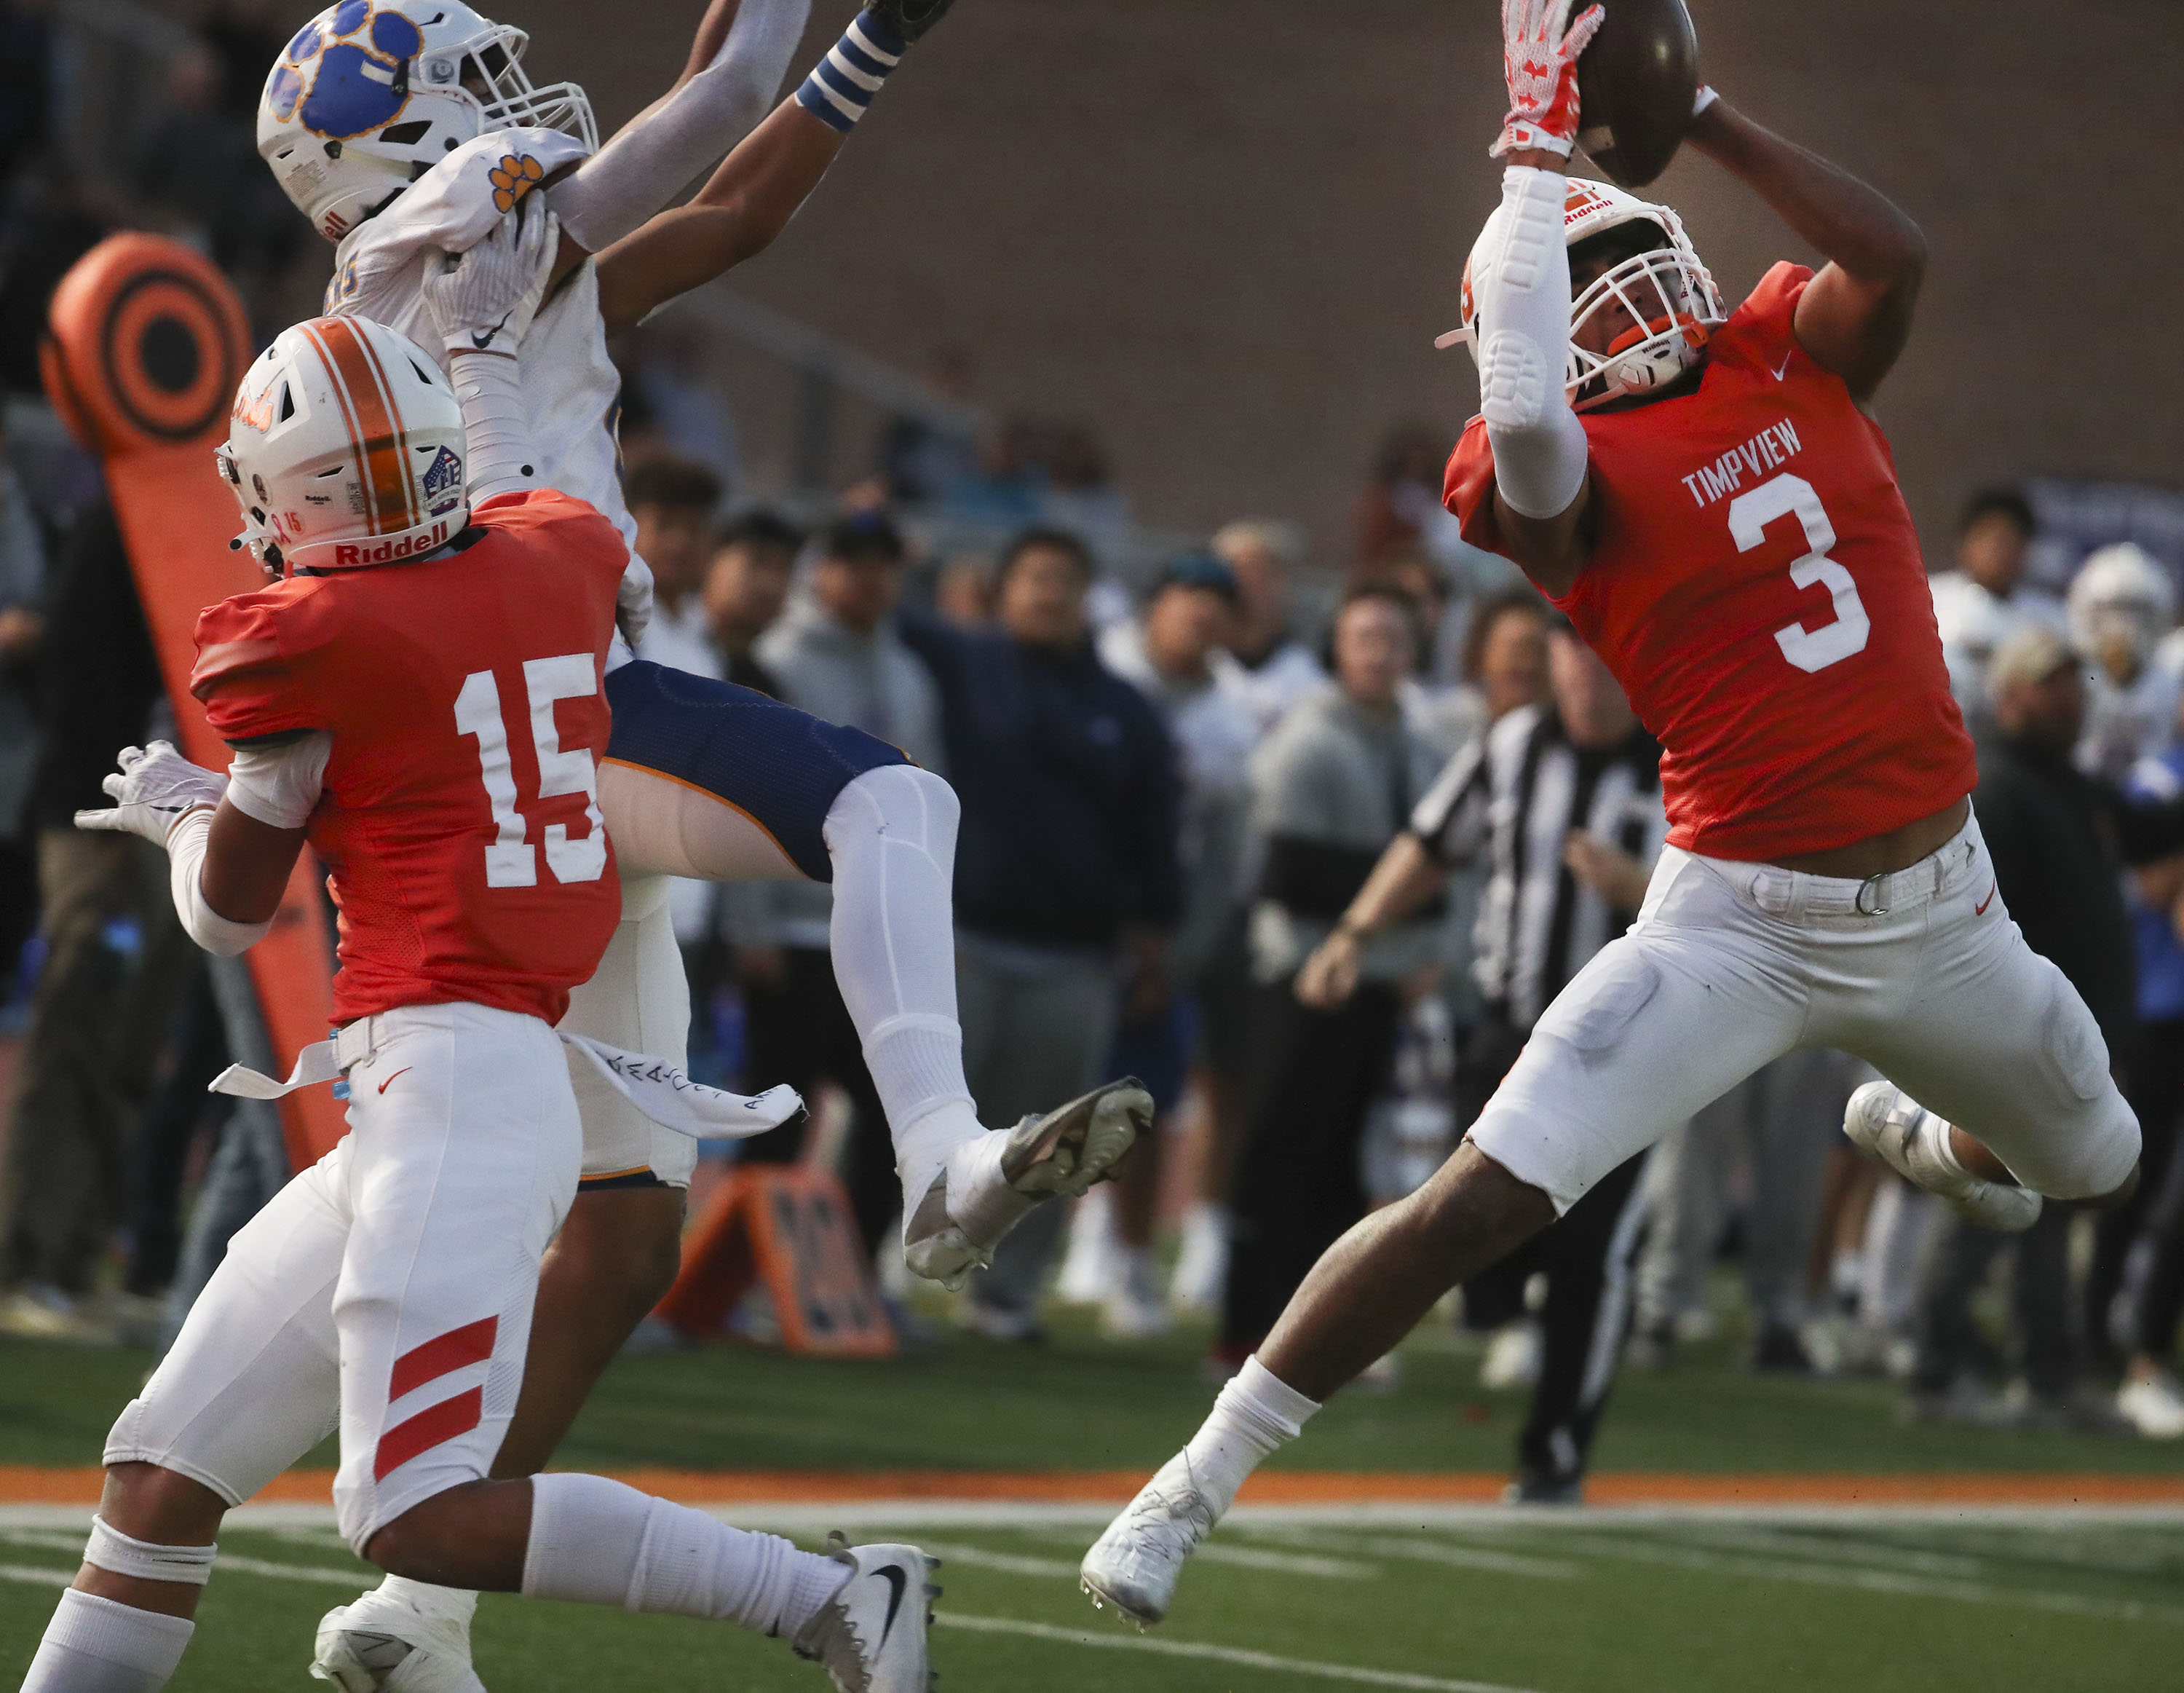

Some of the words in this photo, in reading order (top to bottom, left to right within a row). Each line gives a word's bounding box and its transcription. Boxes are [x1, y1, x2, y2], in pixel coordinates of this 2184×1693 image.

[1564, 200, 1613, 225] Riddell
[1681, 417, 1803, 508] TIMPVIEW
[284, 512, 302, 532] 15
[336, 520, 448, 565] Riddell
[1728, 472, 1871, 674] 3
[454, 653, 606, 888] 15
